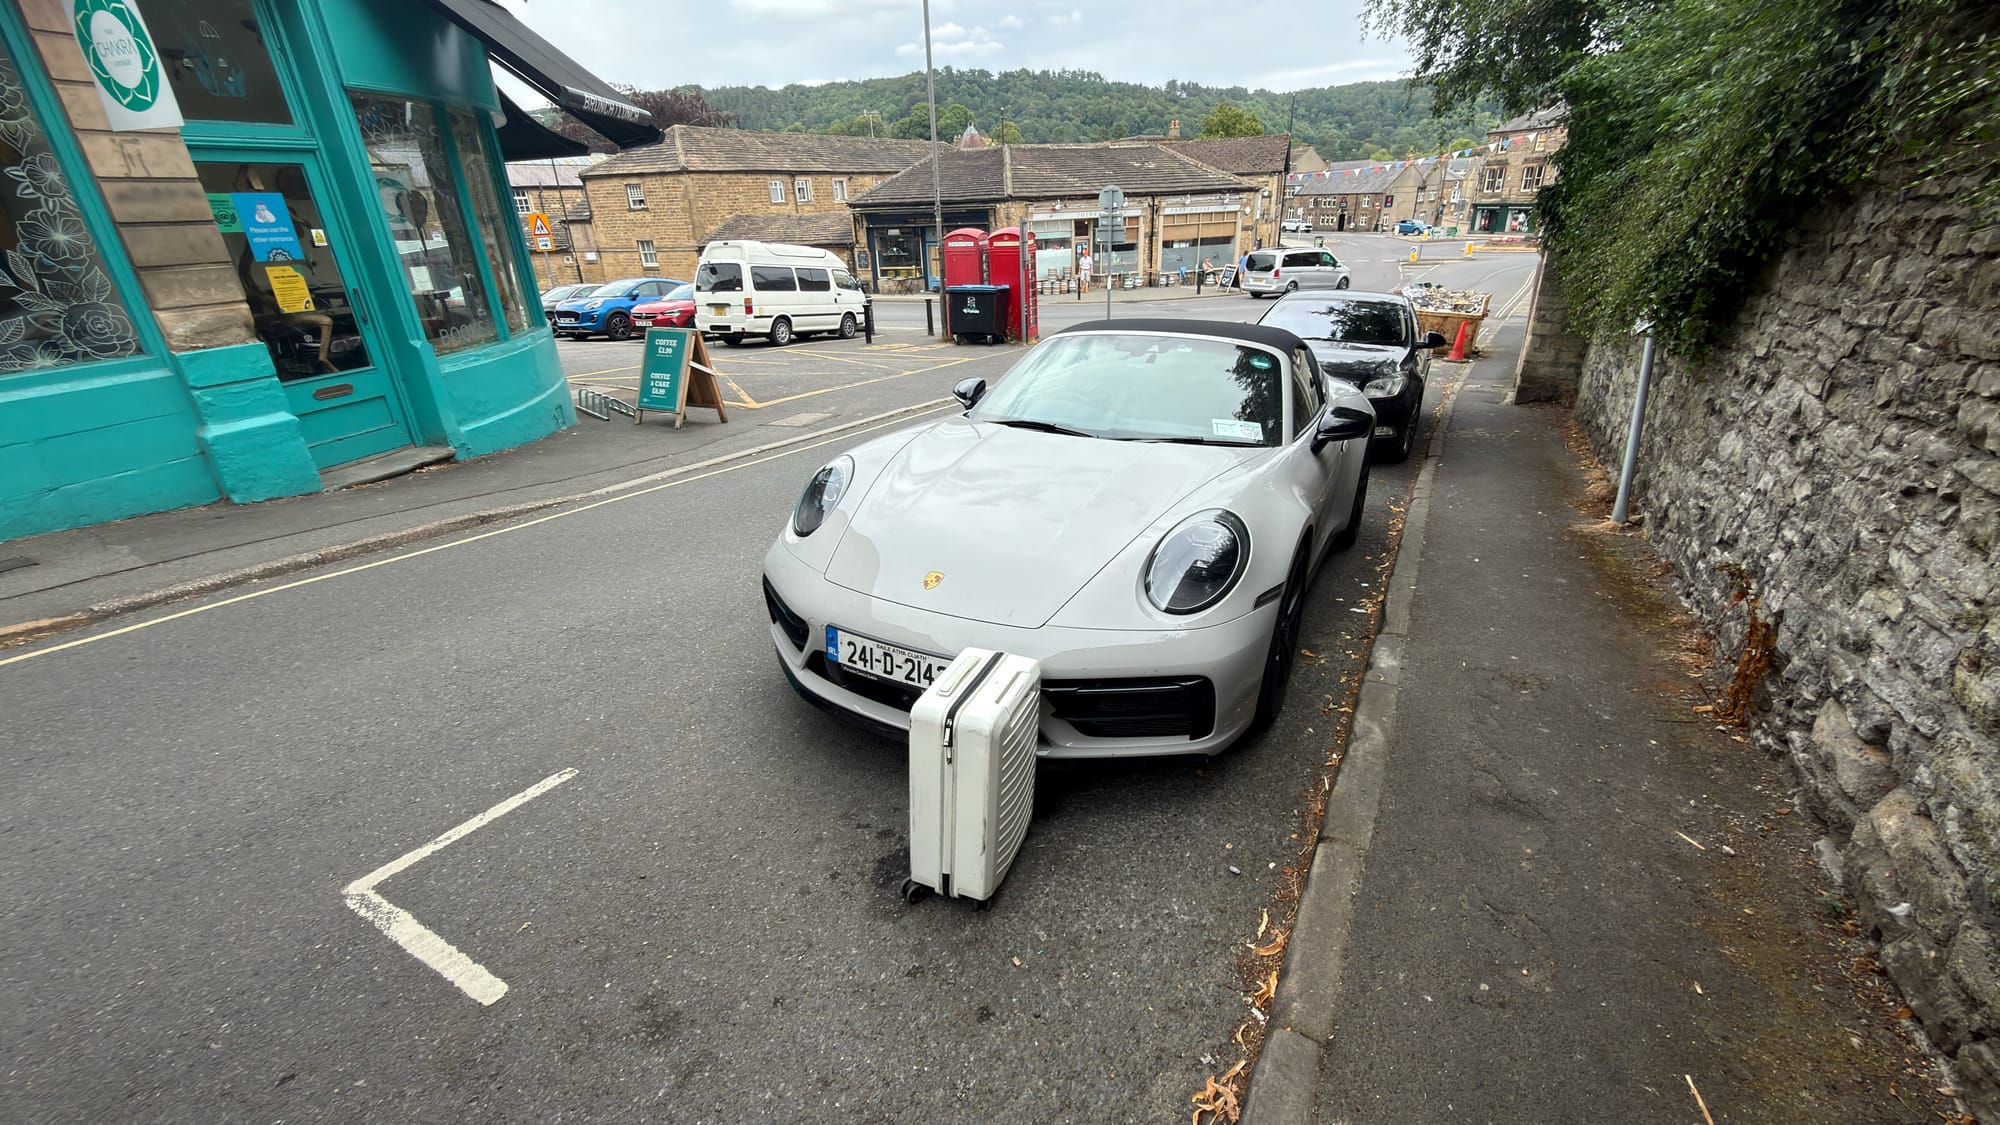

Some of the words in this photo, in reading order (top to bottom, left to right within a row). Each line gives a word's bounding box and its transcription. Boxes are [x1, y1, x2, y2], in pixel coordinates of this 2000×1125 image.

[96, 39, 137, 58] CHAKRA
[650, 372, 671, 380] COFFEE
[828, 646, 838, 656] IRL
[876, 643, 891, 653] BAILE
[908, 651, 927, 661] CLIATH
